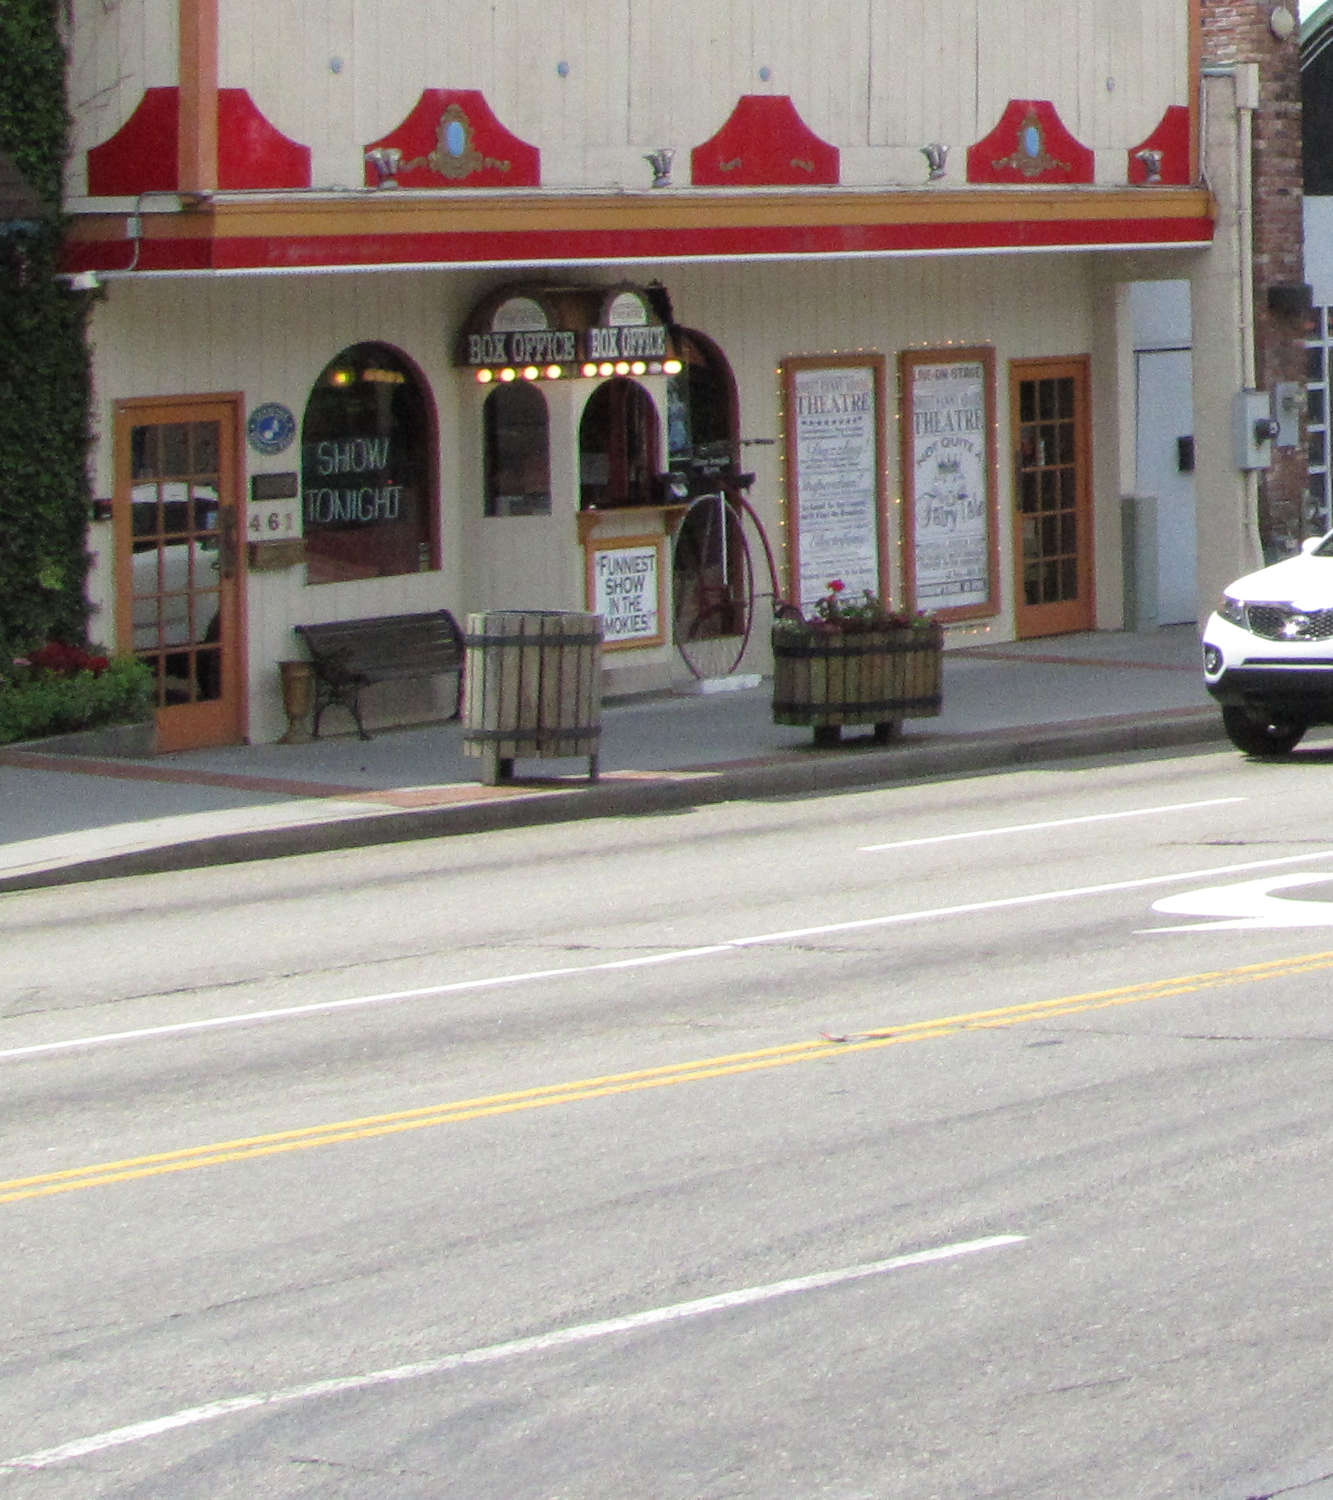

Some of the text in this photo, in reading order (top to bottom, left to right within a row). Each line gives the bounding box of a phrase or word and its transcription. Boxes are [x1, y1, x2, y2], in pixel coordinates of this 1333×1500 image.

[469, 331, 576, 364] BOX OFFICE
[590, 325, 666, 358] BOX OFFICE
[797, 391, 870, 416] THEATRE
[914, 408, 983, 435] THEATRE
[318, 437, 390, 475] SHOW
[941, 436, 975, 453] QUITE
[305, 485, 403, 522] TONIGHT
[605, 574, 646, 596] SHOW
[609, 594, 643, 614] IN THE
